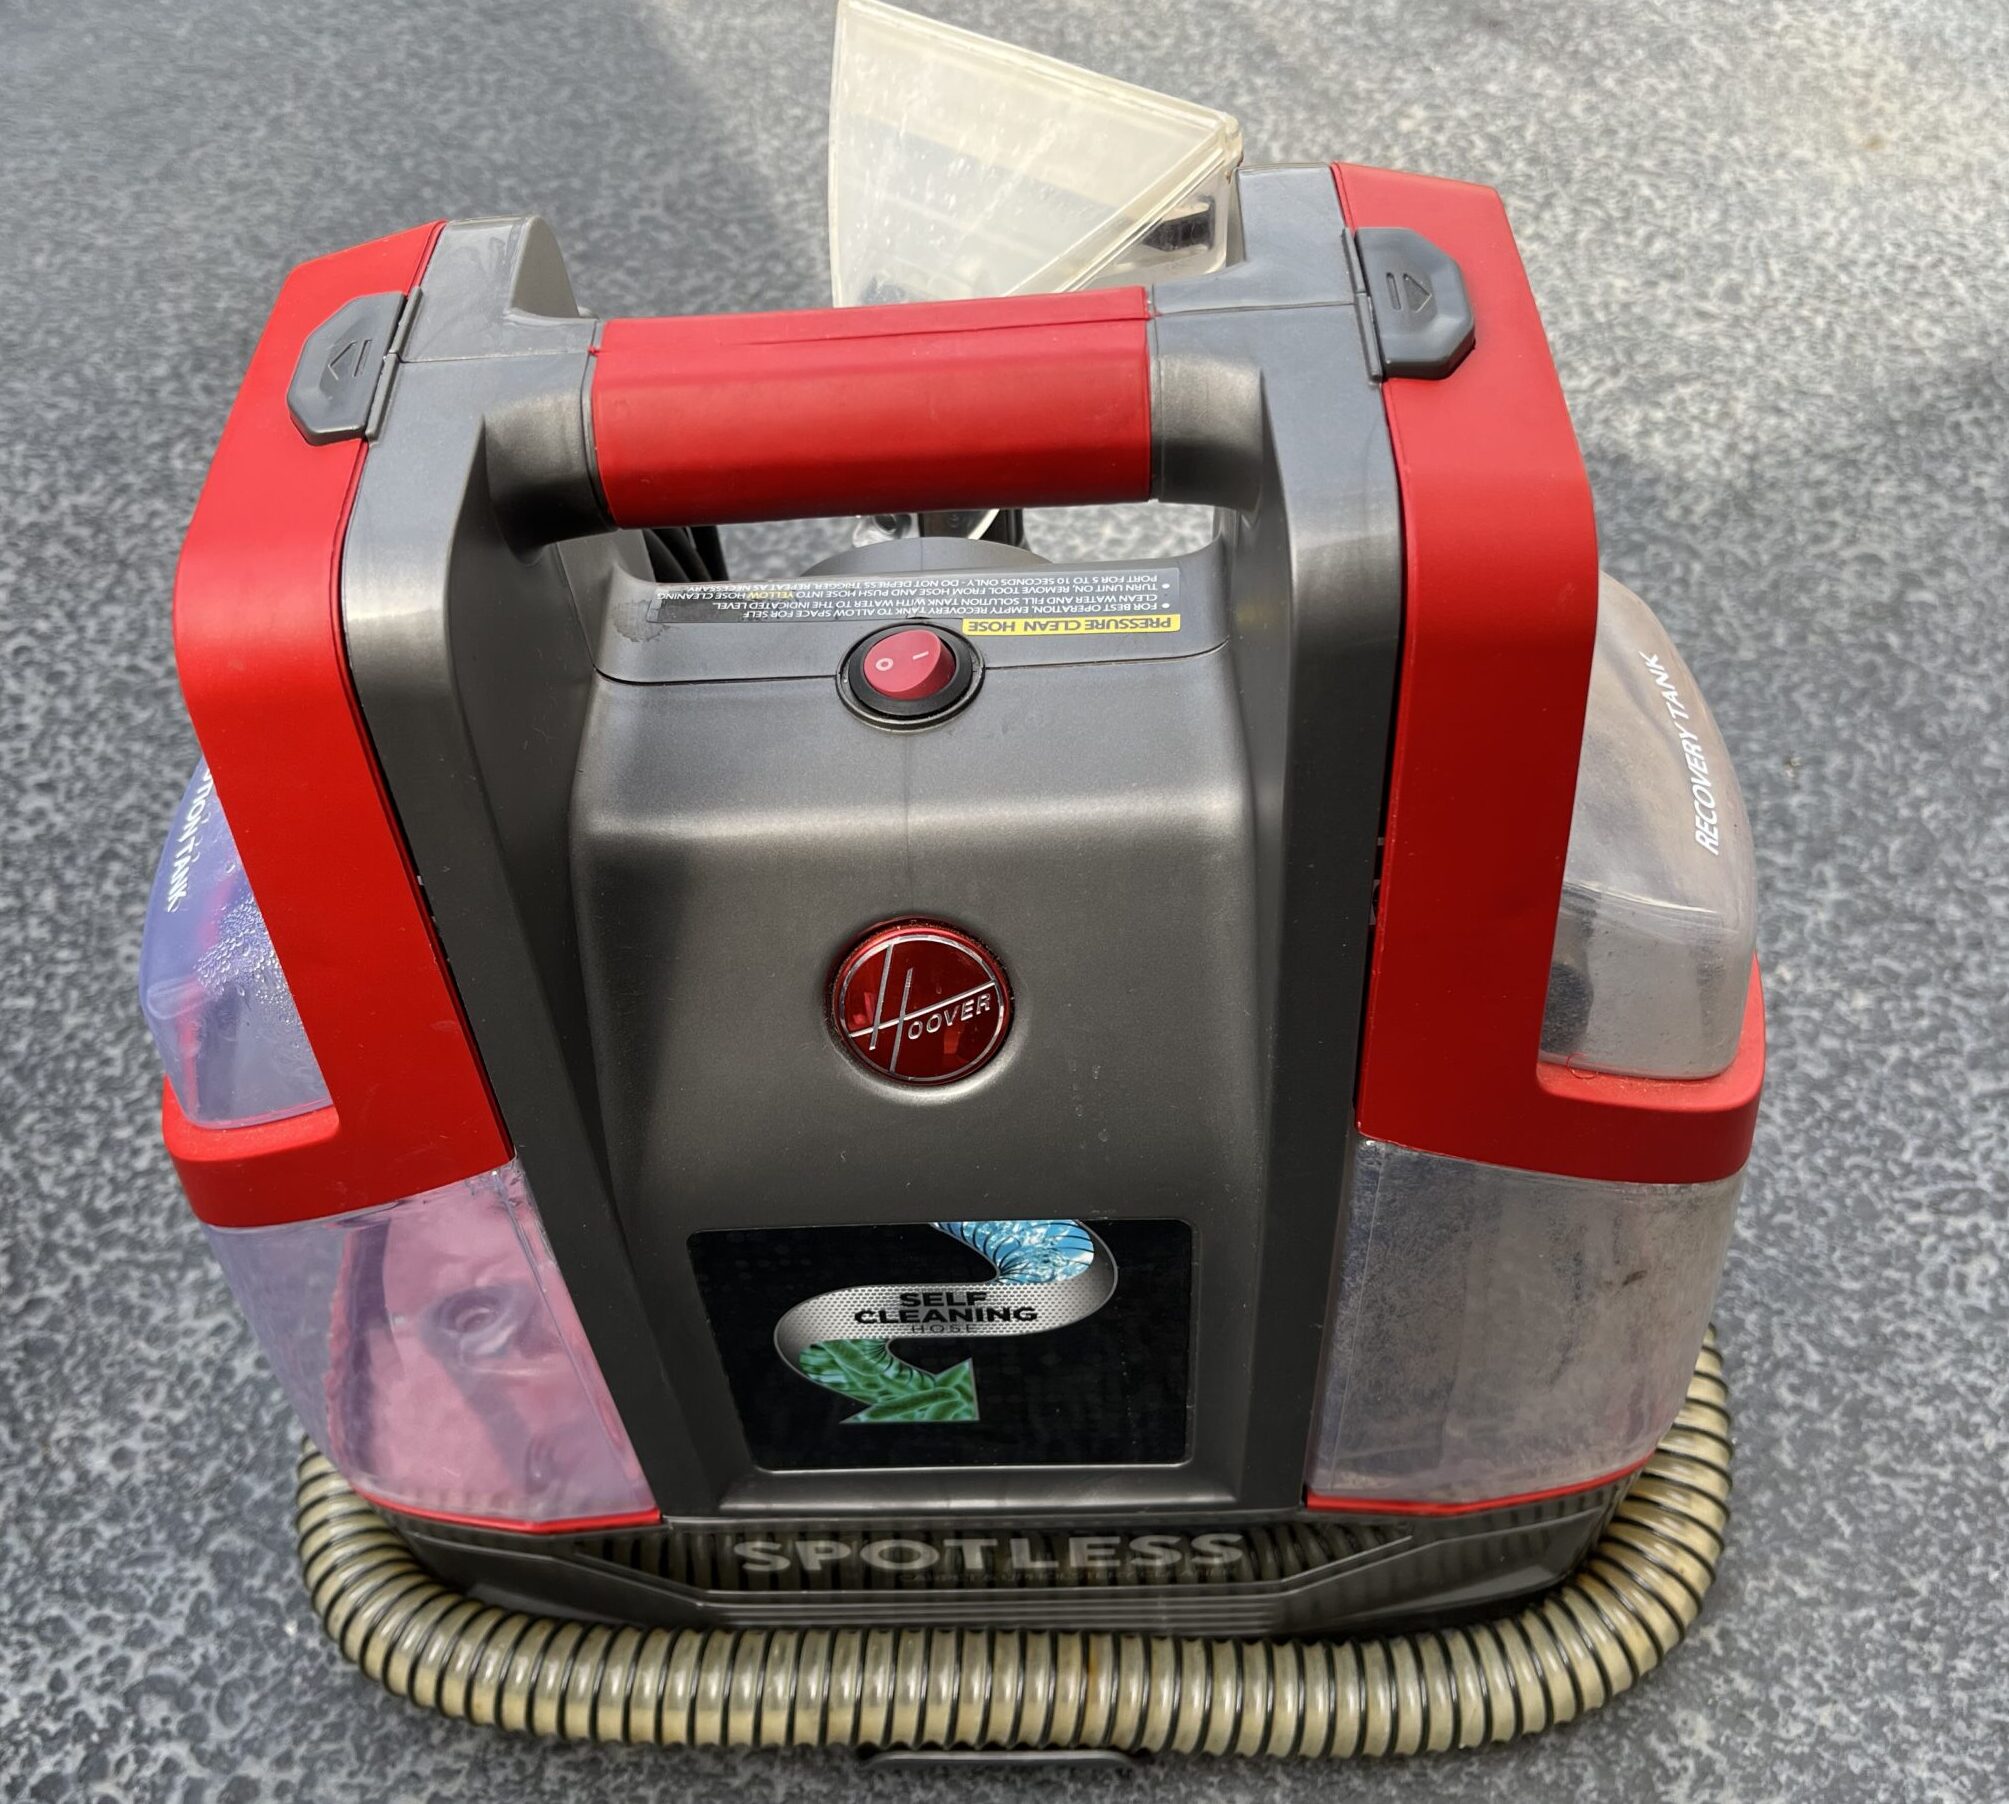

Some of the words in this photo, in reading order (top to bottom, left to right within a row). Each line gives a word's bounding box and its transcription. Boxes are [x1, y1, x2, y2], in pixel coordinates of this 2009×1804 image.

[968, 579, 999, 587] ONLY
[1001, 578, 1055, 586] SECONDS
[1057, 577, 1069, 585] 10
[1127, 575, 1158, 583] PORT
[754, 583, 769, 591] AS
[770, 582, 811, 591] REPEAT
[864, 581, 912, 589] DEPRESS
[914, 580, 939, 588] NOT
[1095, 584, 1123, 592] UNIT
[1125, 583, 1158, 591] TURN
[795, 590, 824, 598] INTO
[826, 590, 856, 598] HOSE
[859, 589, 889, 597] PUSH
[891, 588, 918, 596] AND
[952, 587, 986, 595] FROM
[988, 586, 1020, 594] TOOL
[1021, 586, 1070, 594] REMOVE
[656, 591, 714, 600] CLEANING
[714, 591, 746, 599] HOSE
[746, 591, 794, 599] YELLOW
[1075, 595, 1118, 603] WATER
[1118, 594, 1158, 602] CLEAN
[835, 600, 851, 608] TO
[853, 599, 894, 607] WATER
[895, 599, 927, 607] WITH
[927, 598, 958, 606] TANK
[960, 597, 1020, 605] SOLUTION
[1046, 596, 1074, 604] AND
[748, 601, 810, 609] INDICATED
[1103, 603, 1131, 611] BEST
[1133, 602, 1158, 610] FOR
[742, 610, 769, 618] SELF
[770, 610, 794, 618] FOR
[795, 609, 832, 617] SPACE
[833, 608, 876, 616] ALLOW
[896, 607, 926, 615] TANK
[929, 606, 988, 614] RECOVERY
[967, 621, 1016, 632] HOSE
[1023, 620, 1081, 631] CLEAN
[1084, 617, 1171, 630] PRESSURE
[1638, 650, 1690, 720] TANK
[1674, 721, 1719, 855] RECOVERY
[177, 768, 214, 843] UTION
[167, 836, 196, 913] TANK
[848, 943, 997, 1074] HOOVER
[899, 1291, 988, 1308] SELF
[853, 1306, 1039, 1325] CLEANING
[911, 1323, 978, 1334] HOSE
[732, 1532, 1244, 1573] SPOTLESS
